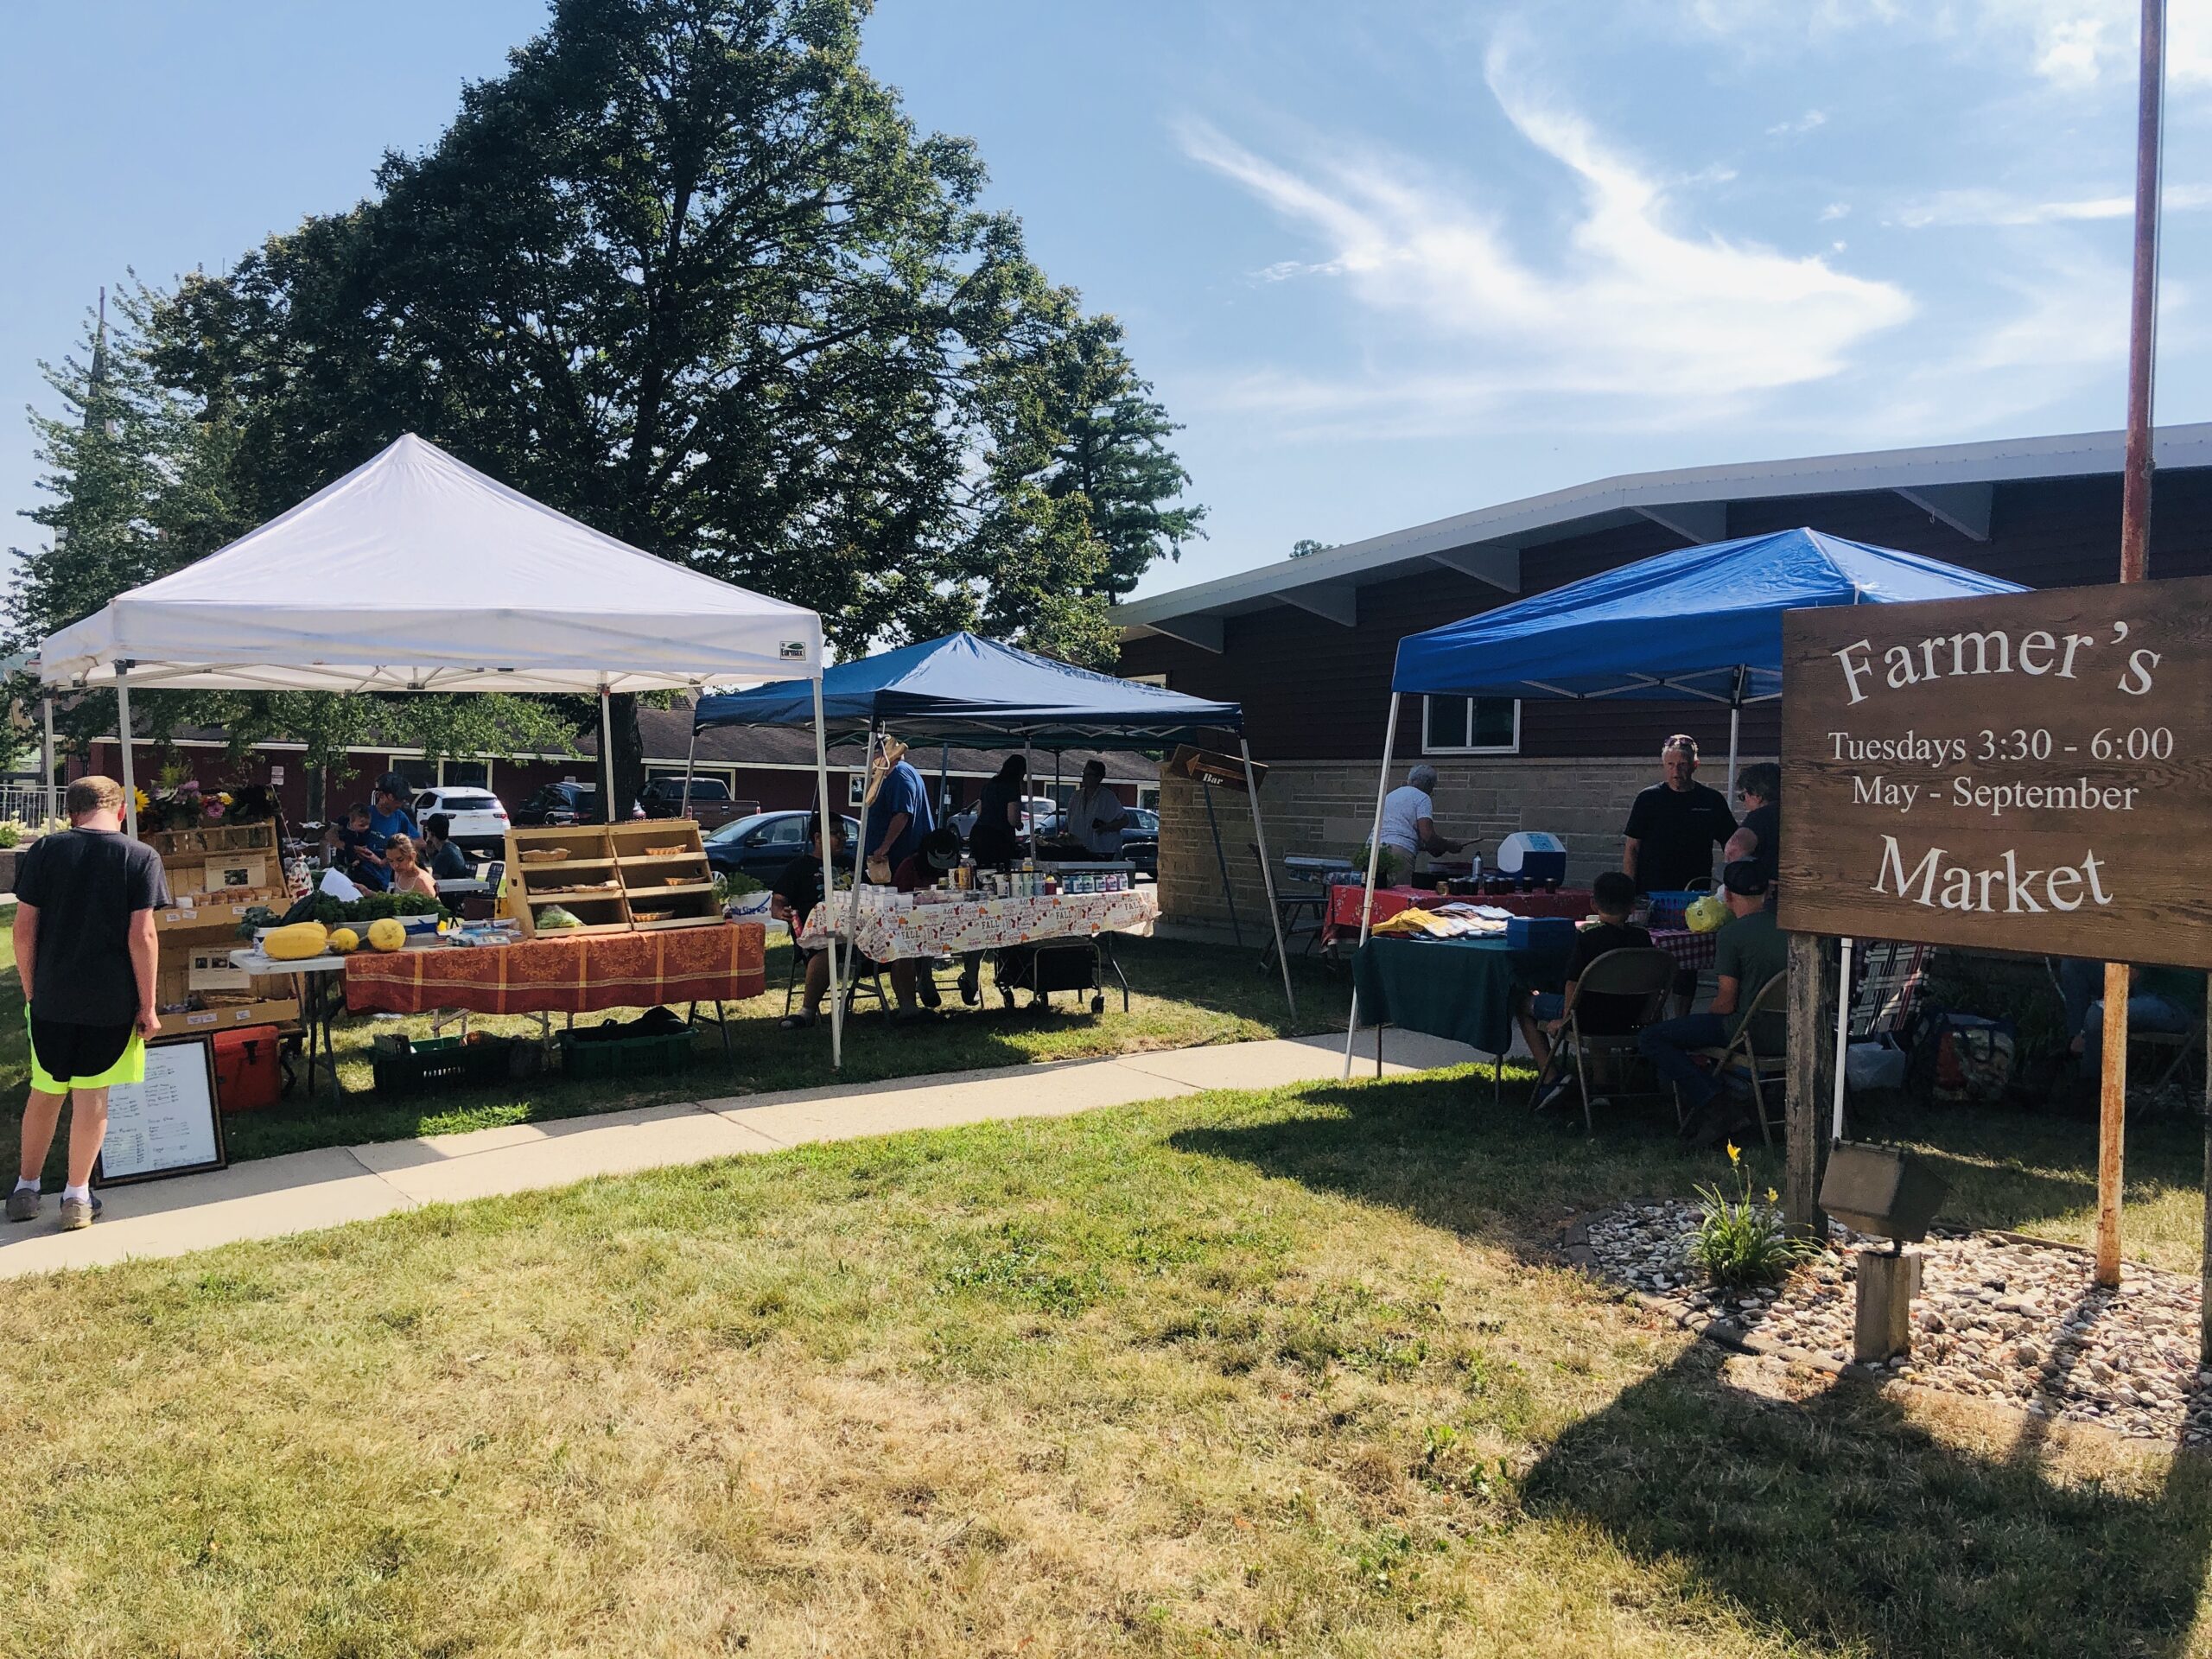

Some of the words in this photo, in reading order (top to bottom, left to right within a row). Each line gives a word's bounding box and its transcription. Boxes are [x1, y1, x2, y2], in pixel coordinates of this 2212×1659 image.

[1831, 620, 2161, 706] Farmer's
[1827, 729, 1967, 768] Tuesdays
[1978, 728, 2052, 760] 3:30
[2091, 727, 2173, 760] 6:00
[1202, 772, 1224, 785] Bar
[1852, 776, 1920, 813] May
[1953, 776, 2139, 817] September
[1869, 834, 2113, 913] Market
[982, 920, 1000, 929] FALL
[1056, 911, 1072, 919] FALL
